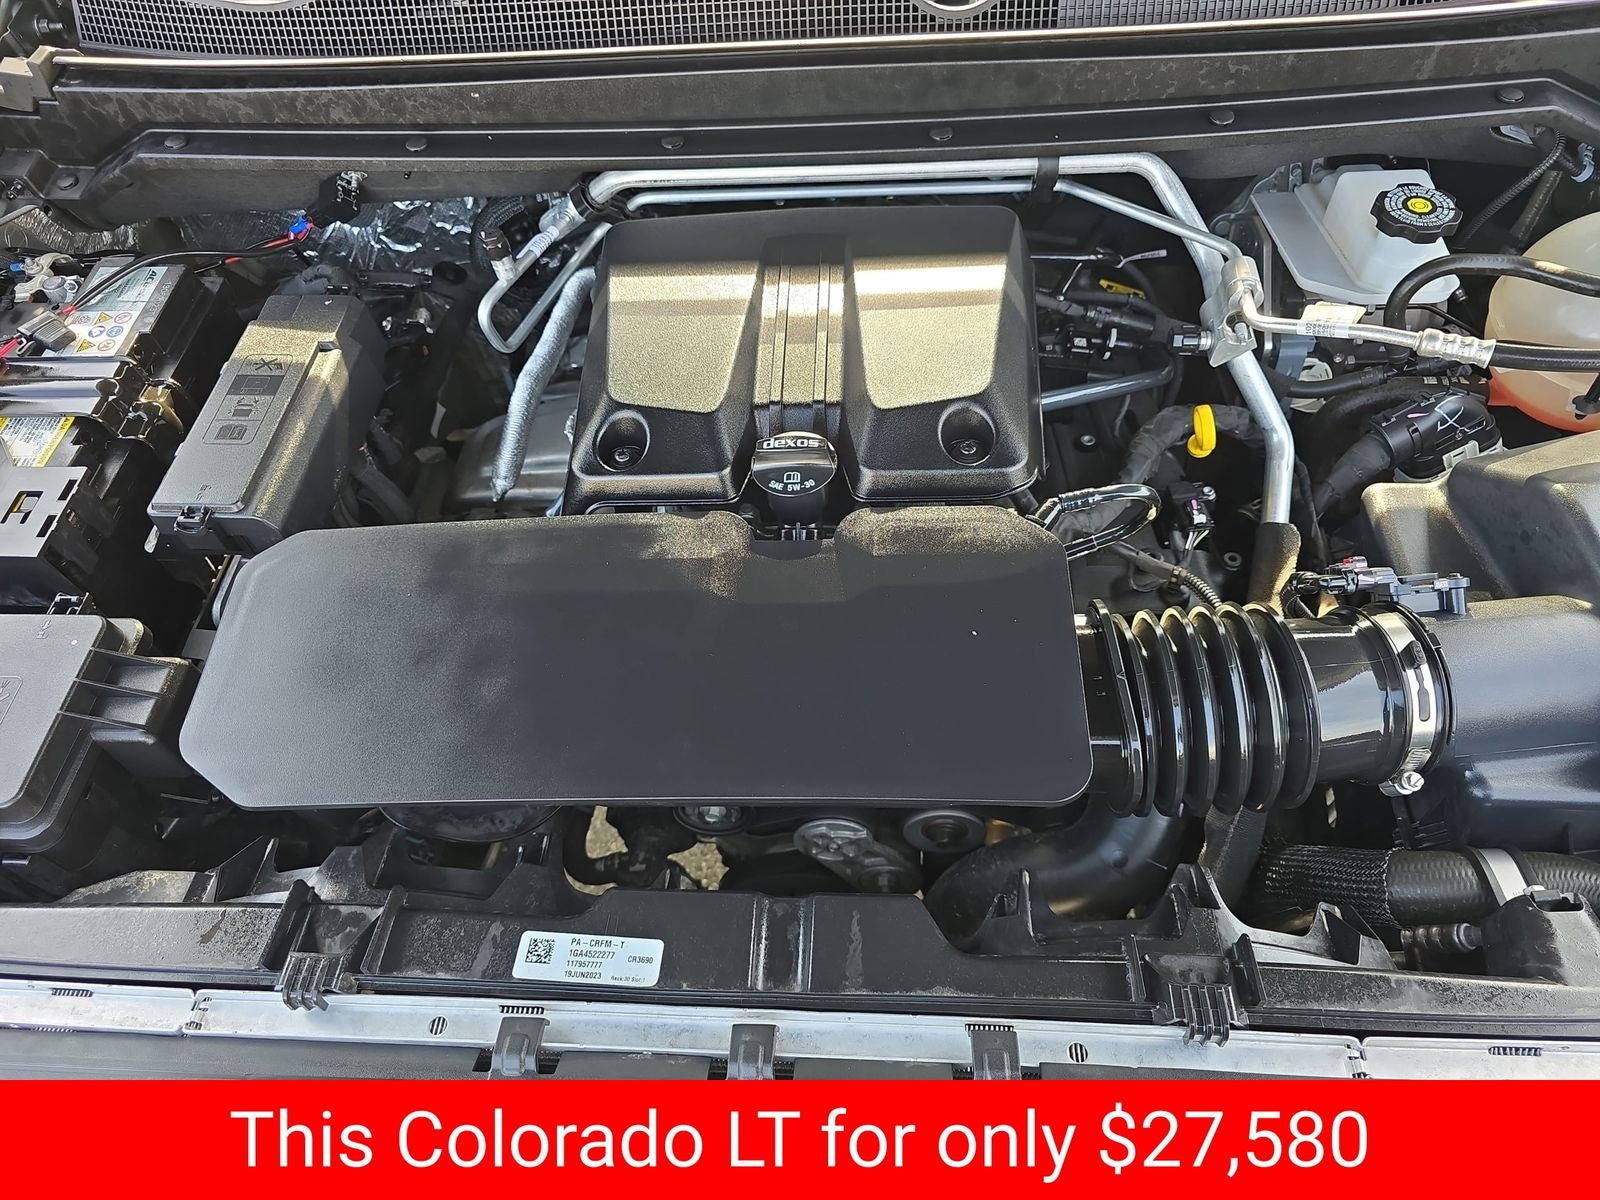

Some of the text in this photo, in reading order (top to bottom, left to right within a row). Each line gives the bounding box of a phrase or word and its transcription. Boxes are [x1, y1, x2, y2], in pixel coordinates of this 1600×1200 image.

[763, 438, 819, 449] dexos
[768, 479, 815, 491] SAE 5W-30
[569, 949, 616, 960] 1GA4522277
[627, 955, 653, 964] CR3690
[566, 959, 603, 969] 117957777
[564, 970, 602, 980] 19JUN2023
